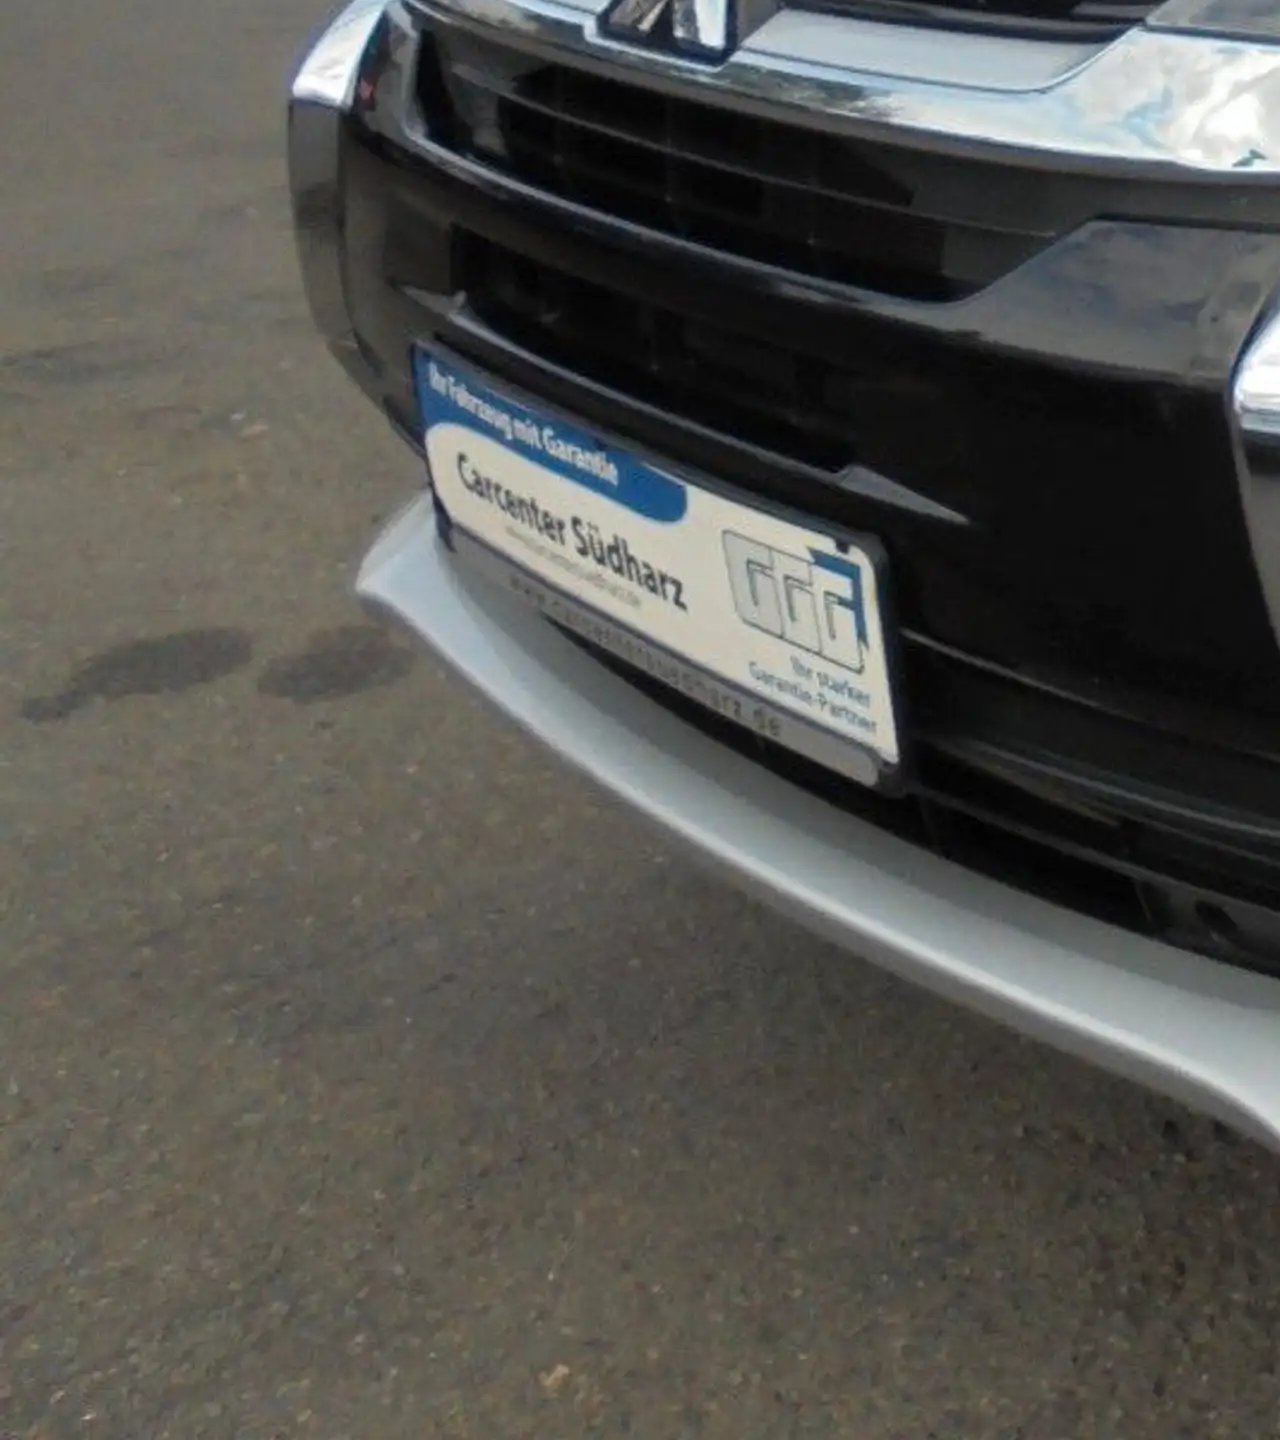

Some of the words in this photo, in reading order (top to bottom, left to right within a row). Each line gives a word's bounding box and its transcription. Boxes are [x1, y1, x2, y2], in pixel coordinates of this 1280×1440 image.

[542, 426, 619, 486] Garantie
[457, 452, 567, 546] Carcenter
[570, 515, 689, 612] Südharz
